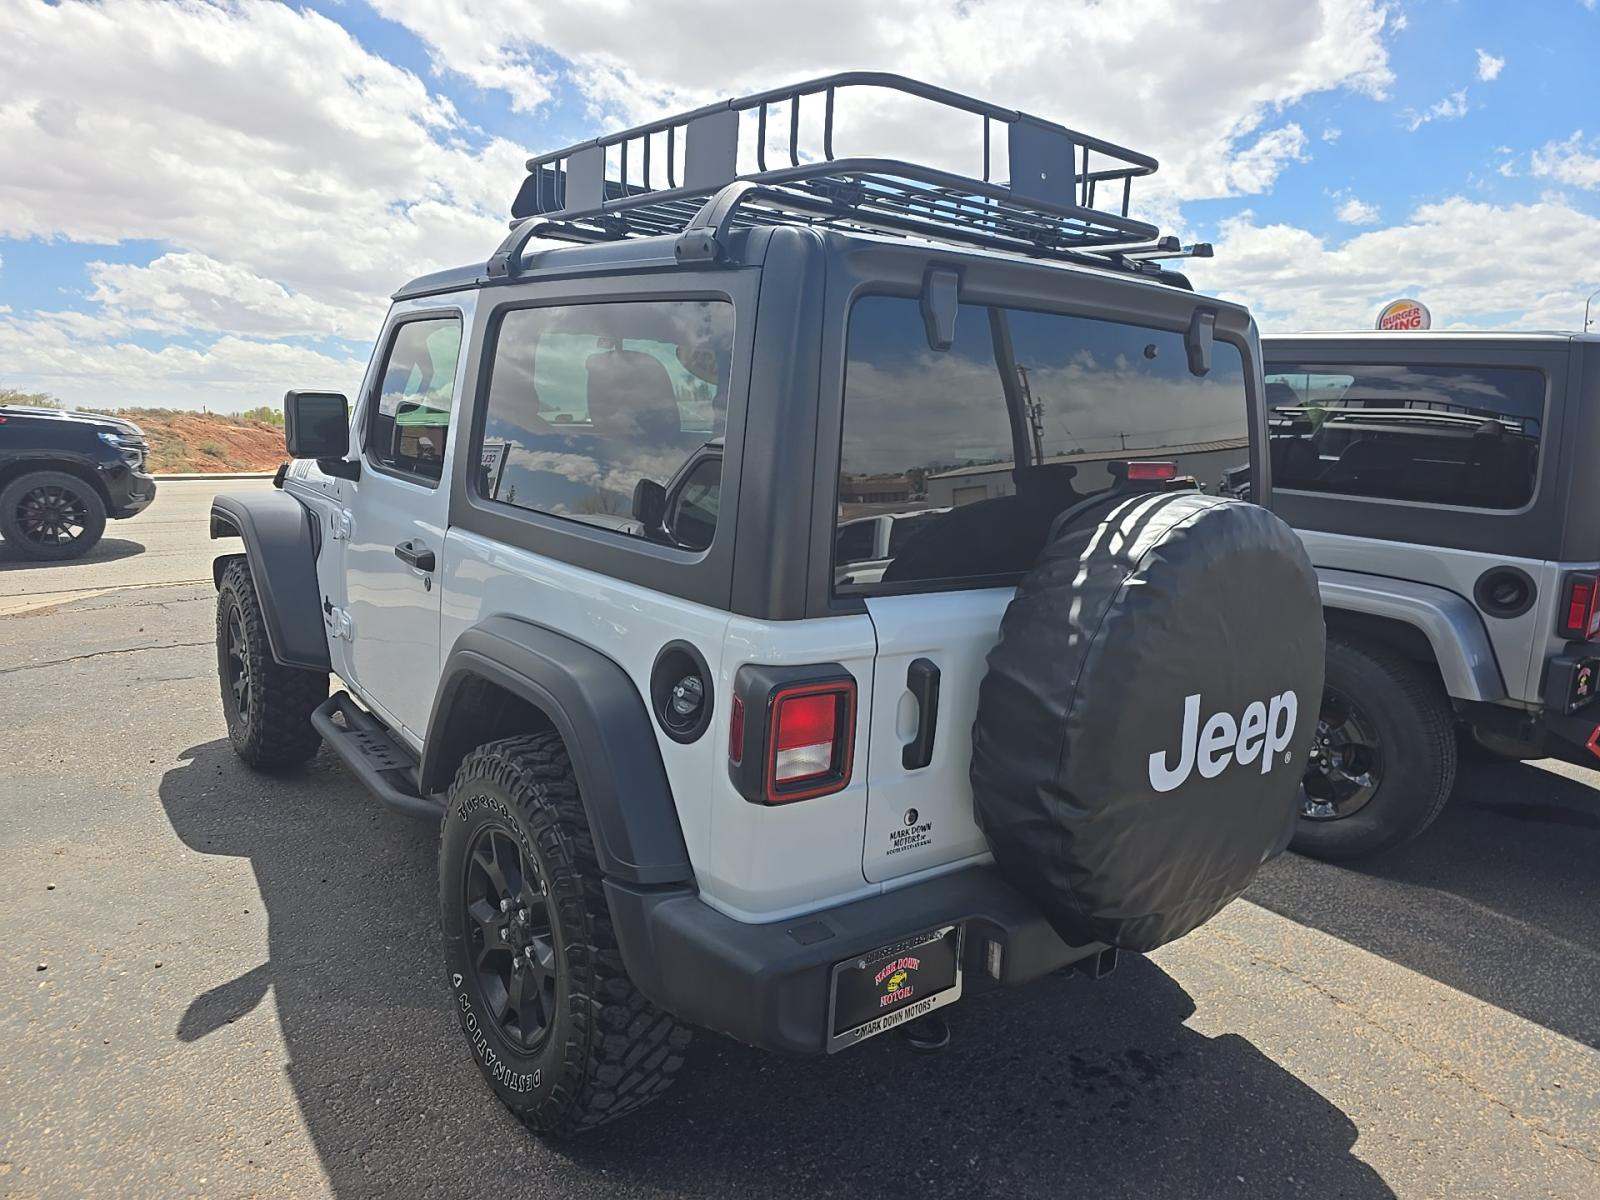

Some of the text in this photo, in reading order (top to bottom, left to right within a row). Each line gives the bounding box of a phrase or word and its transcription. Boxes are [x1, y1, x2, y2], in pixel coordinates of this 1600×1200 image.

[1383, 308, 1420, 327] BURGER
[1149, 690, 1298, 792] Jeep
[890, 828, 911, 842] MARK
[911, 821, 932, 835] DOWN
[893, 833, 921, 848] MOTORS
[874, 957, 921, 987] MARK DOWN
[860, 999, 931, 1038] MARK DOWN MOTORS
[458, 992, 541, 1092] DESTINATION
